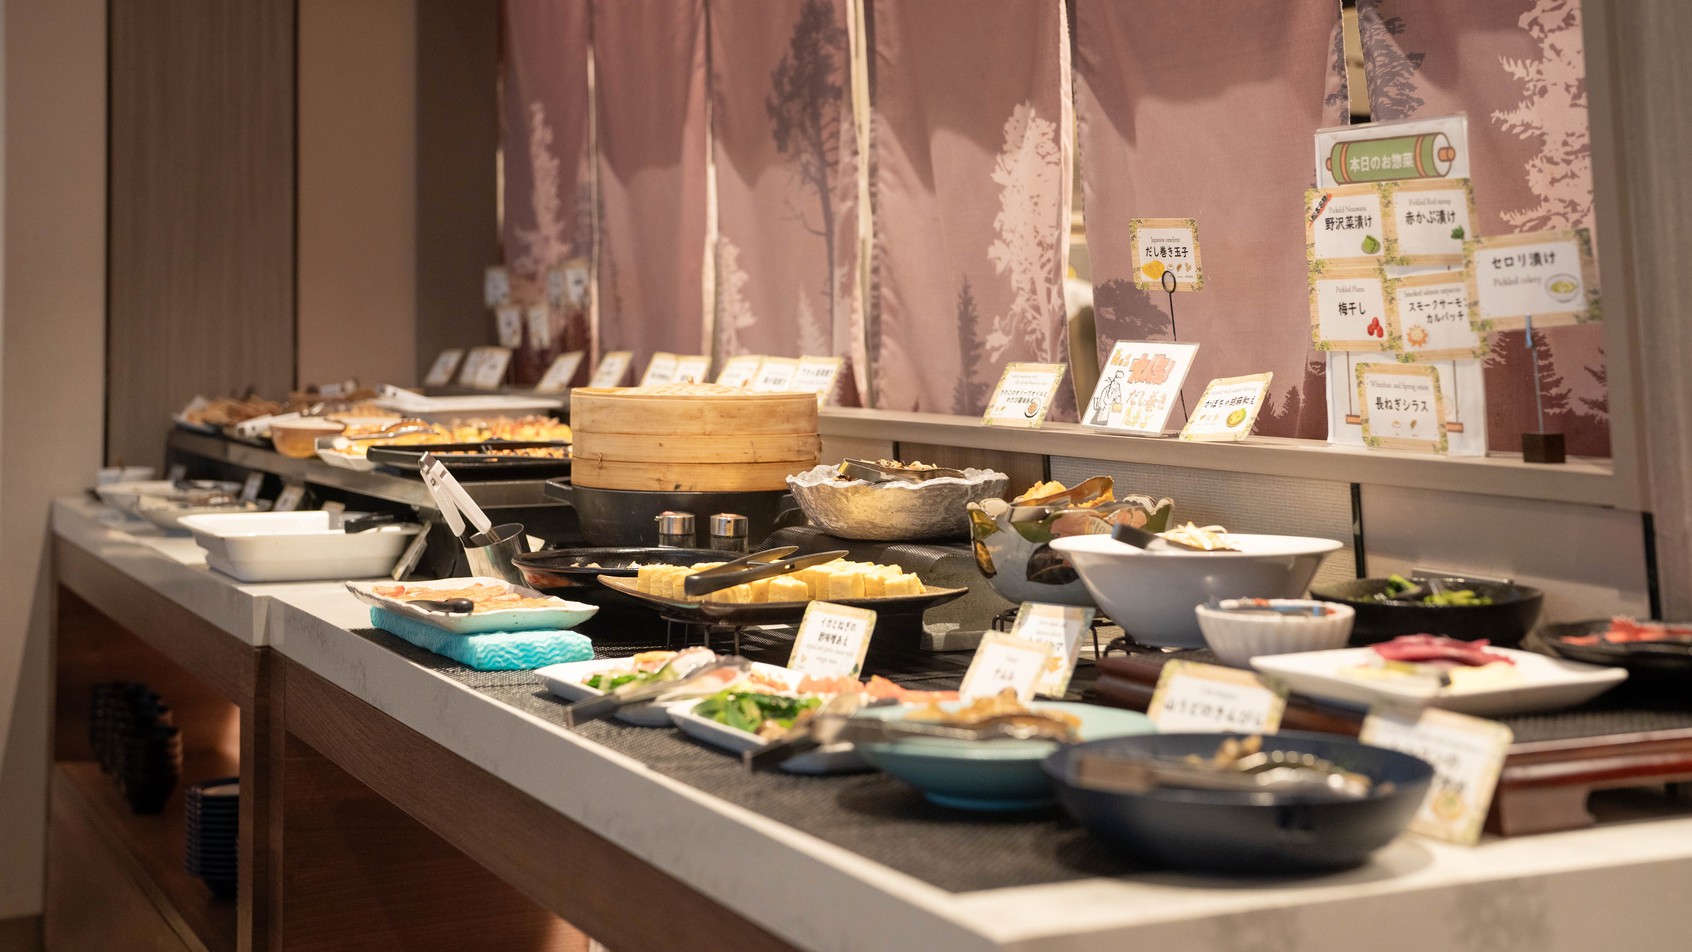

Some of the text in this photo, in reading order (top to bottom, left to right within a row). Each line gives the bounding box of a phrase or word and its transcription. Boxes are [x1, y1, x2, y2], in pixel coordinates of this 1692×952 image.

[1349, 152, 1414, 172] 本日のお惣菜
[1325, 214, 1372, 231] 野沢菜漬け
[1405, 209, 1456, 225] 赤かぶ漬け
[1145, 246, 1189, 258] だし巻き玉子
[1492, 251, 1555, 269] セロリ漬け
[1493, 276, 1518, 287] Pickled
[1338, 301, 1366, 316] 梅干し
[1204, 395, 1256, 408] かぼちゃ胡麻和え
[1375, 397, 1428, 412] 長ねぎシラス
[821, 618, 857, 632] イカとねぎの
